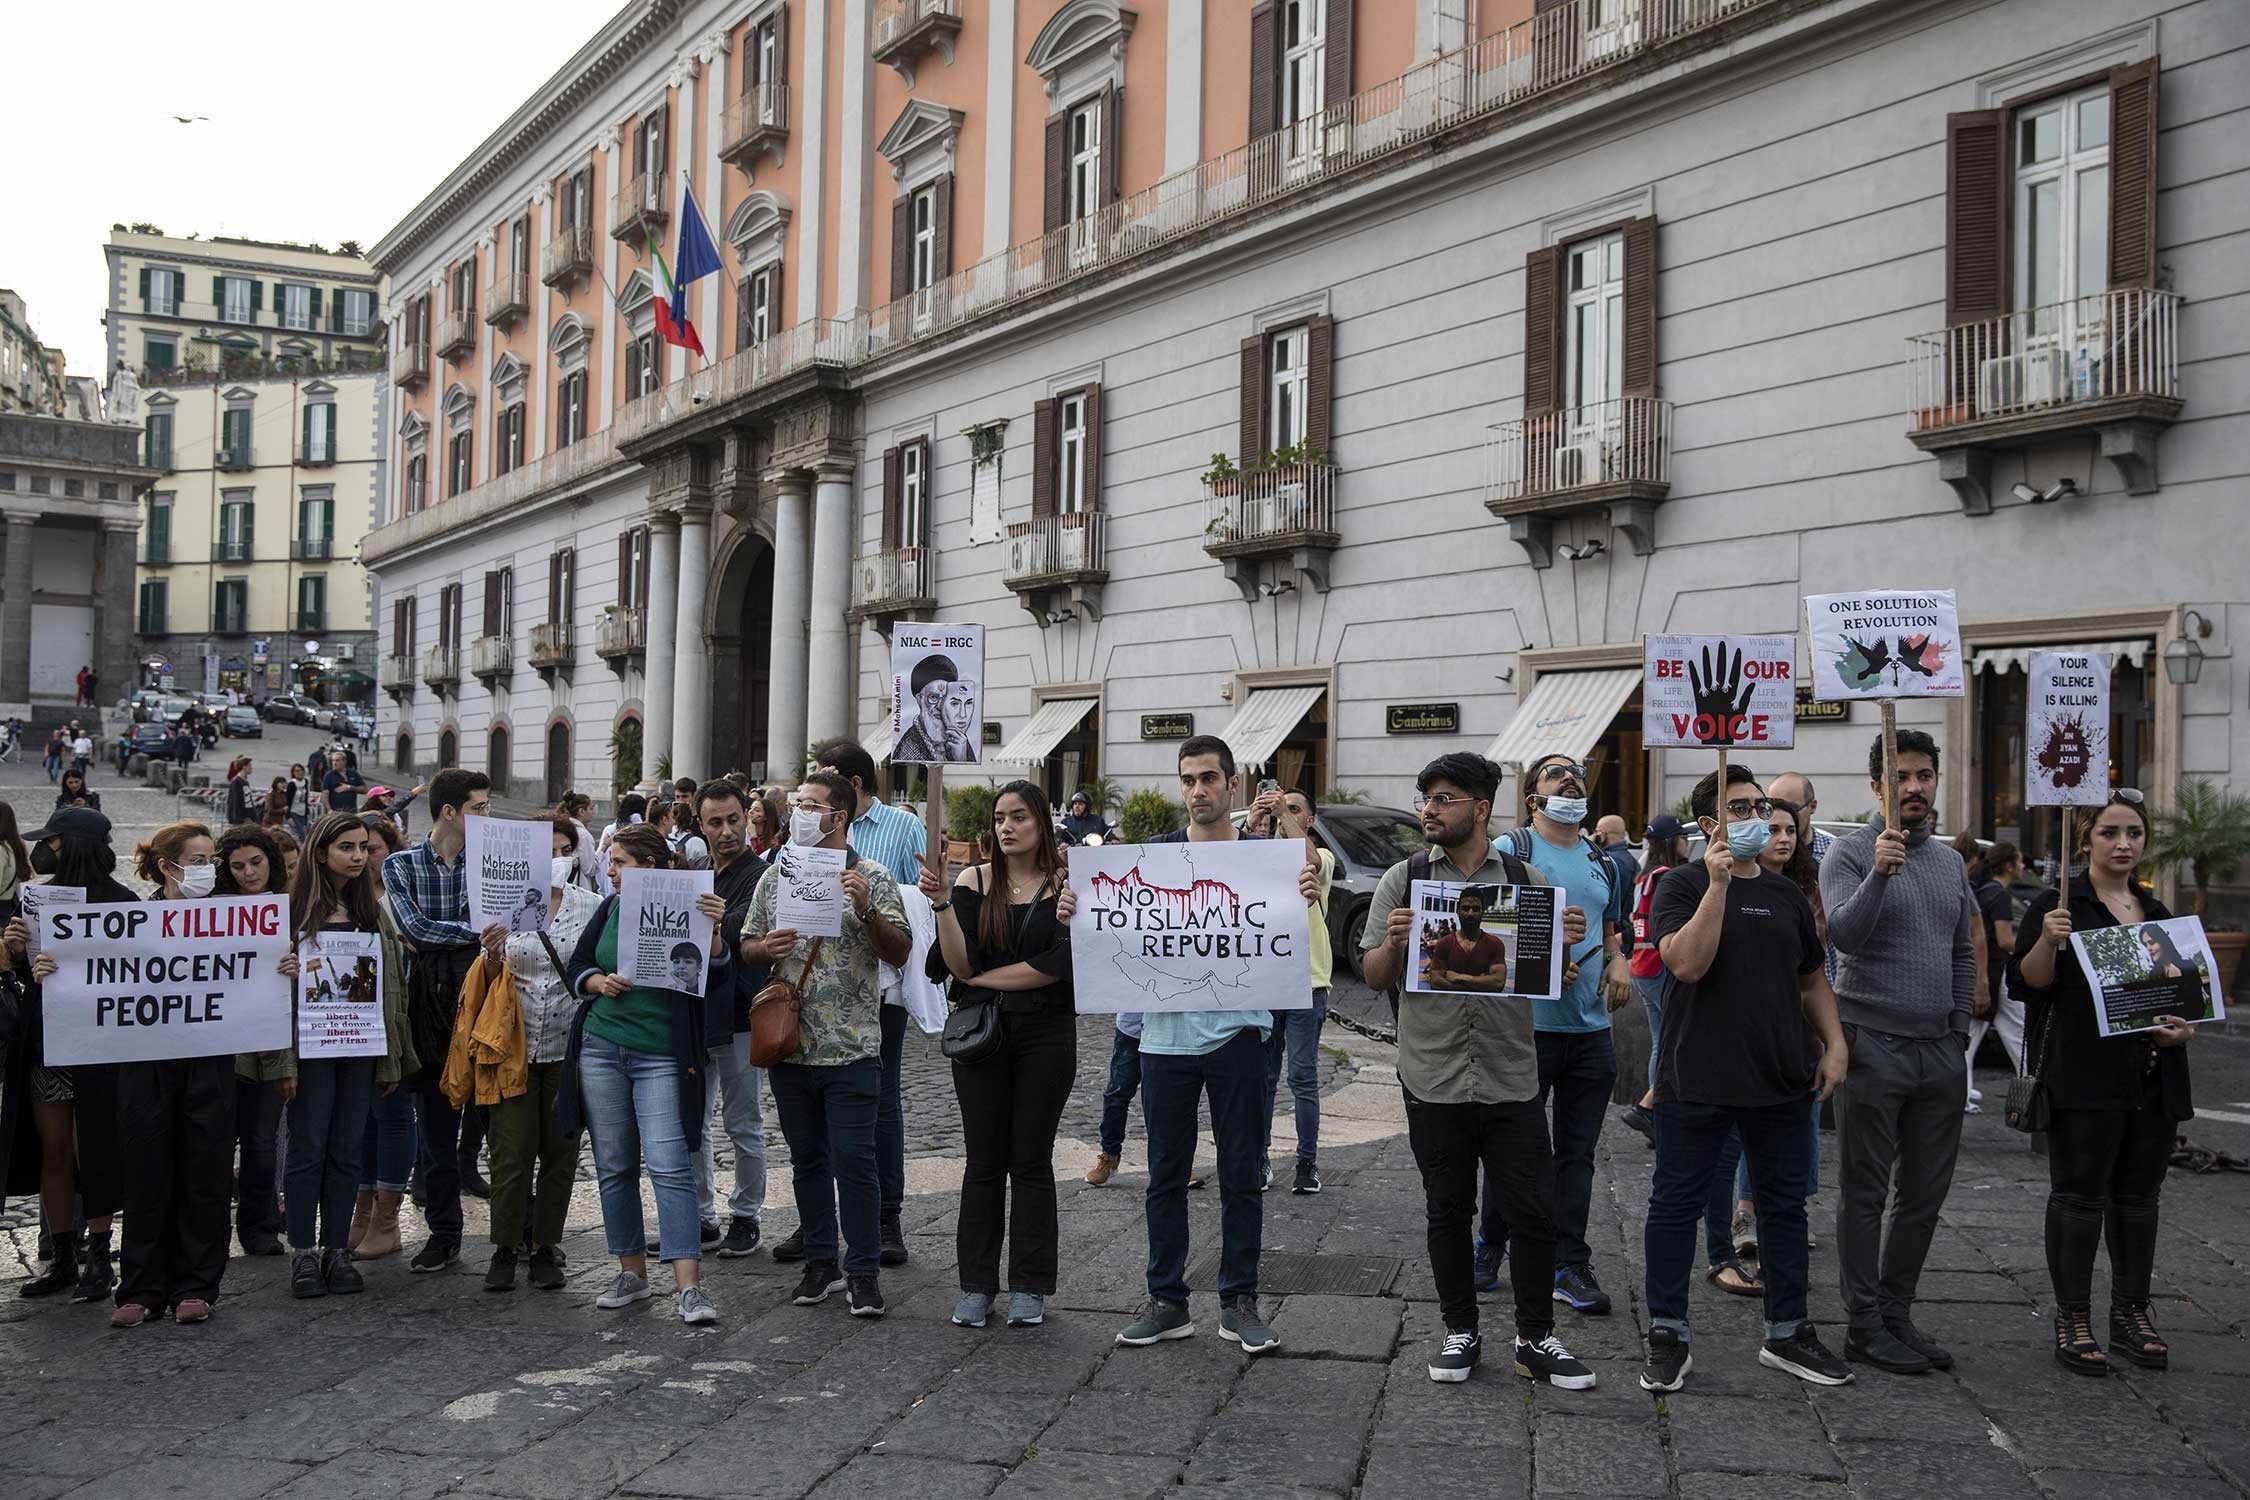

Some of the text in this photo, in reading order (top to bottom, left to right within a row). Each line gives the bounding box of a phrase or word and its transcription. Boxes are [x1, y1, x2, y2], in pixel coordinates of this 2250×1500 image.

[1829, 598, 1938, 613] ONE SOLUTION
[1844, 616, 1938, 630] REVOLUTION
[900, 637, 928, 648] NIAC
[945, 637, 973, 648] IRGC
[1656, 636, 1692, 645] WOMEN
[1748, 638, 1784, 646] WOMEN
[1664, 650, 1683, 658] LIFE
[1758, 651, 1776, 659] LIFE
[1656, 660, 1684, 678] BE
[1744, 660, 1790, 679] OUR
[2059, 658, 2088, 669] YOUR
[2052, 676, 2094, 688] SILENCE
[1664, 688, 1682, 696] LIFE
[1758, 688, 1776, 696] LIFE
[1652, 700, 1694, 708] FREEDOM
[2046, 694, 2098, 706] IS KILLING
[1672, 713, 1769, 740] VOICE
[483, 824, 530, 840] SAY HIS
[482, 838, 530, 859] NAME
[482, 854, 530, 870] Mohsen
[482, 868, 530, 880] MOUSAVI
[642, 876, 694, 892] SAY HER
[642, 890, 692, 910] NAME
[1118, 886, 1154, 909] NO
[52, 904, 280, 940] STOP KILLING
[640, 902, 690, 930] Nika
[1090, 901, 1266, 932] TO ISLAMIC
[639, 926, 690, 938] SHAKARMI
[1141, 934, 1292, 958] REPUBLIC
[86, 952, 258, 984] INNOCENT
[96, 992, 224, 1026] PEOPLE
